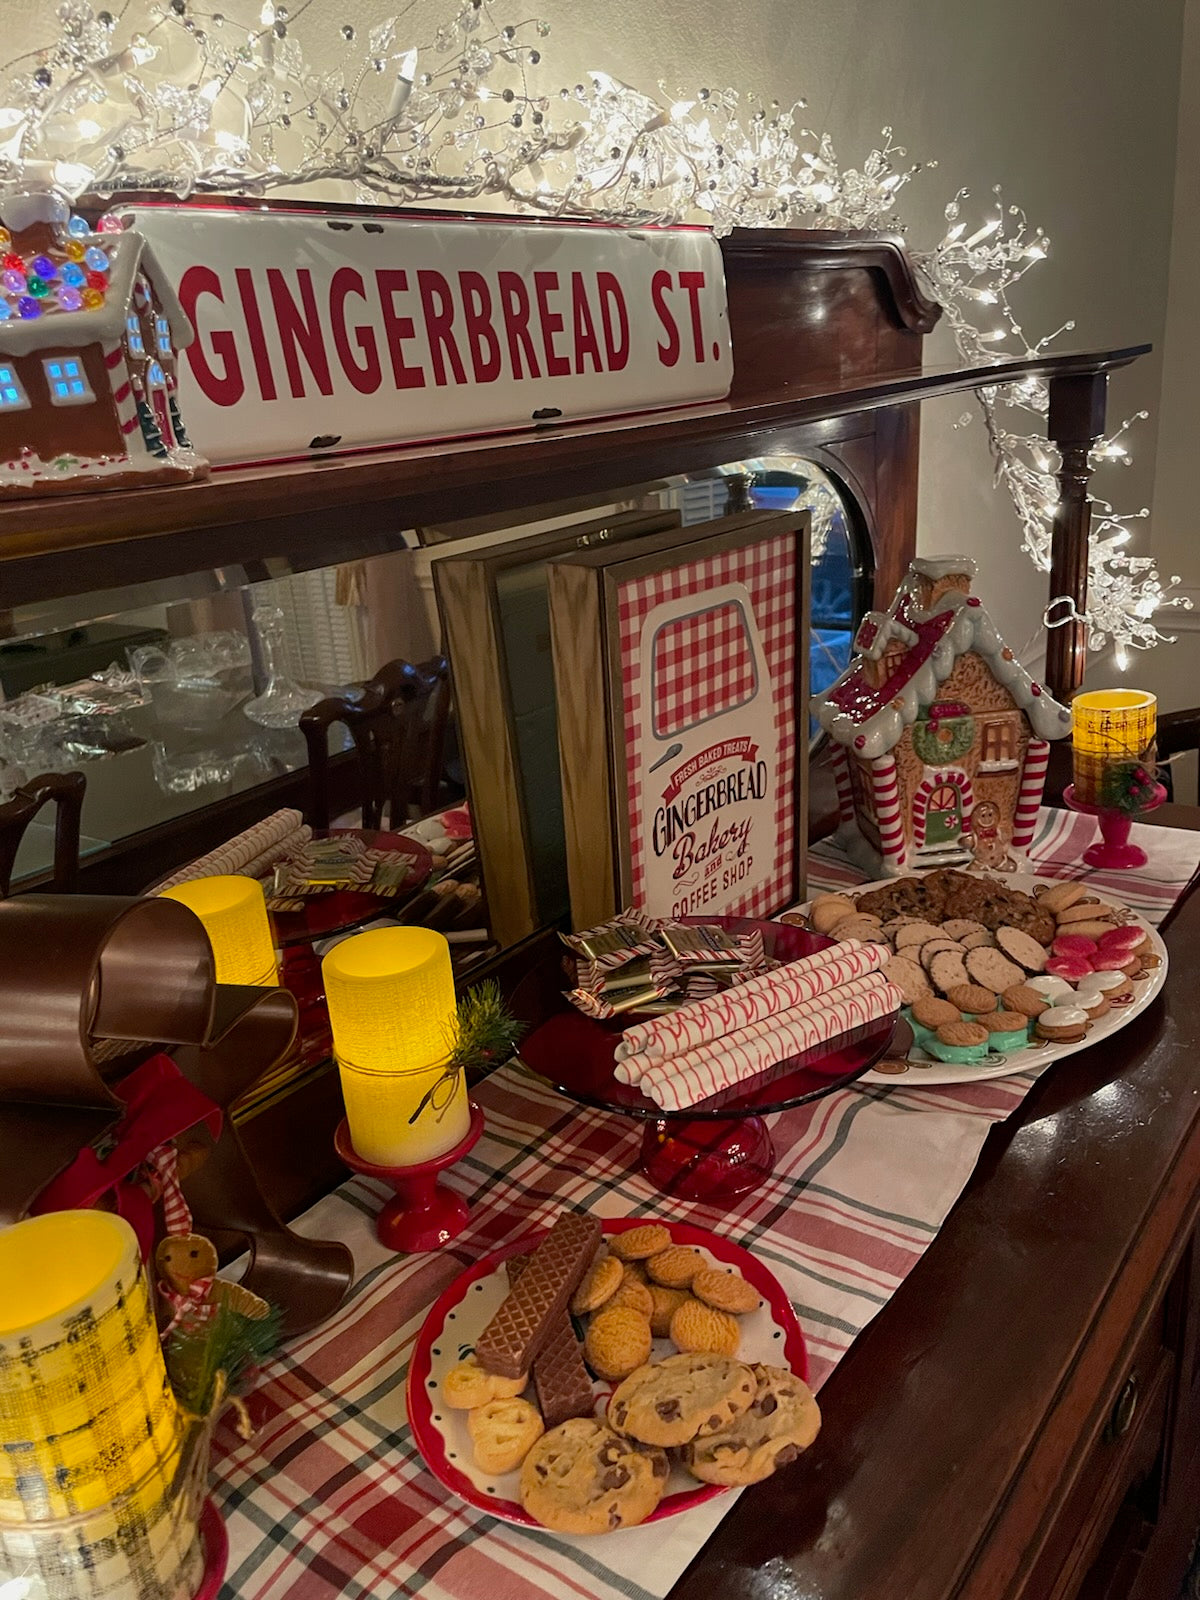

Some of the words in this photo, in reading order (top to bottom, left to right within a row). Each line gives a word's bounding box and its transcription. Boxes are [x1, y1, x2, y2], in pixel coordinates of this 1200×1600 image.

[178, 265, 630, 406] GINGERBREAD
[651, 271, 720, 367] ST.
[674, 761, 698, 786] FRESH
[699, 749, 722, 767] BAKED
[722, 741, 749, 756] TREATS
[653, 760, 767, 857] GINGERBREAD
[673, 816, 753, 879] Bakery
[704, 854, 722, 877] and
[672, 878, 717, 918] COFFEE
[723, 856, 753, 890] SHOP
